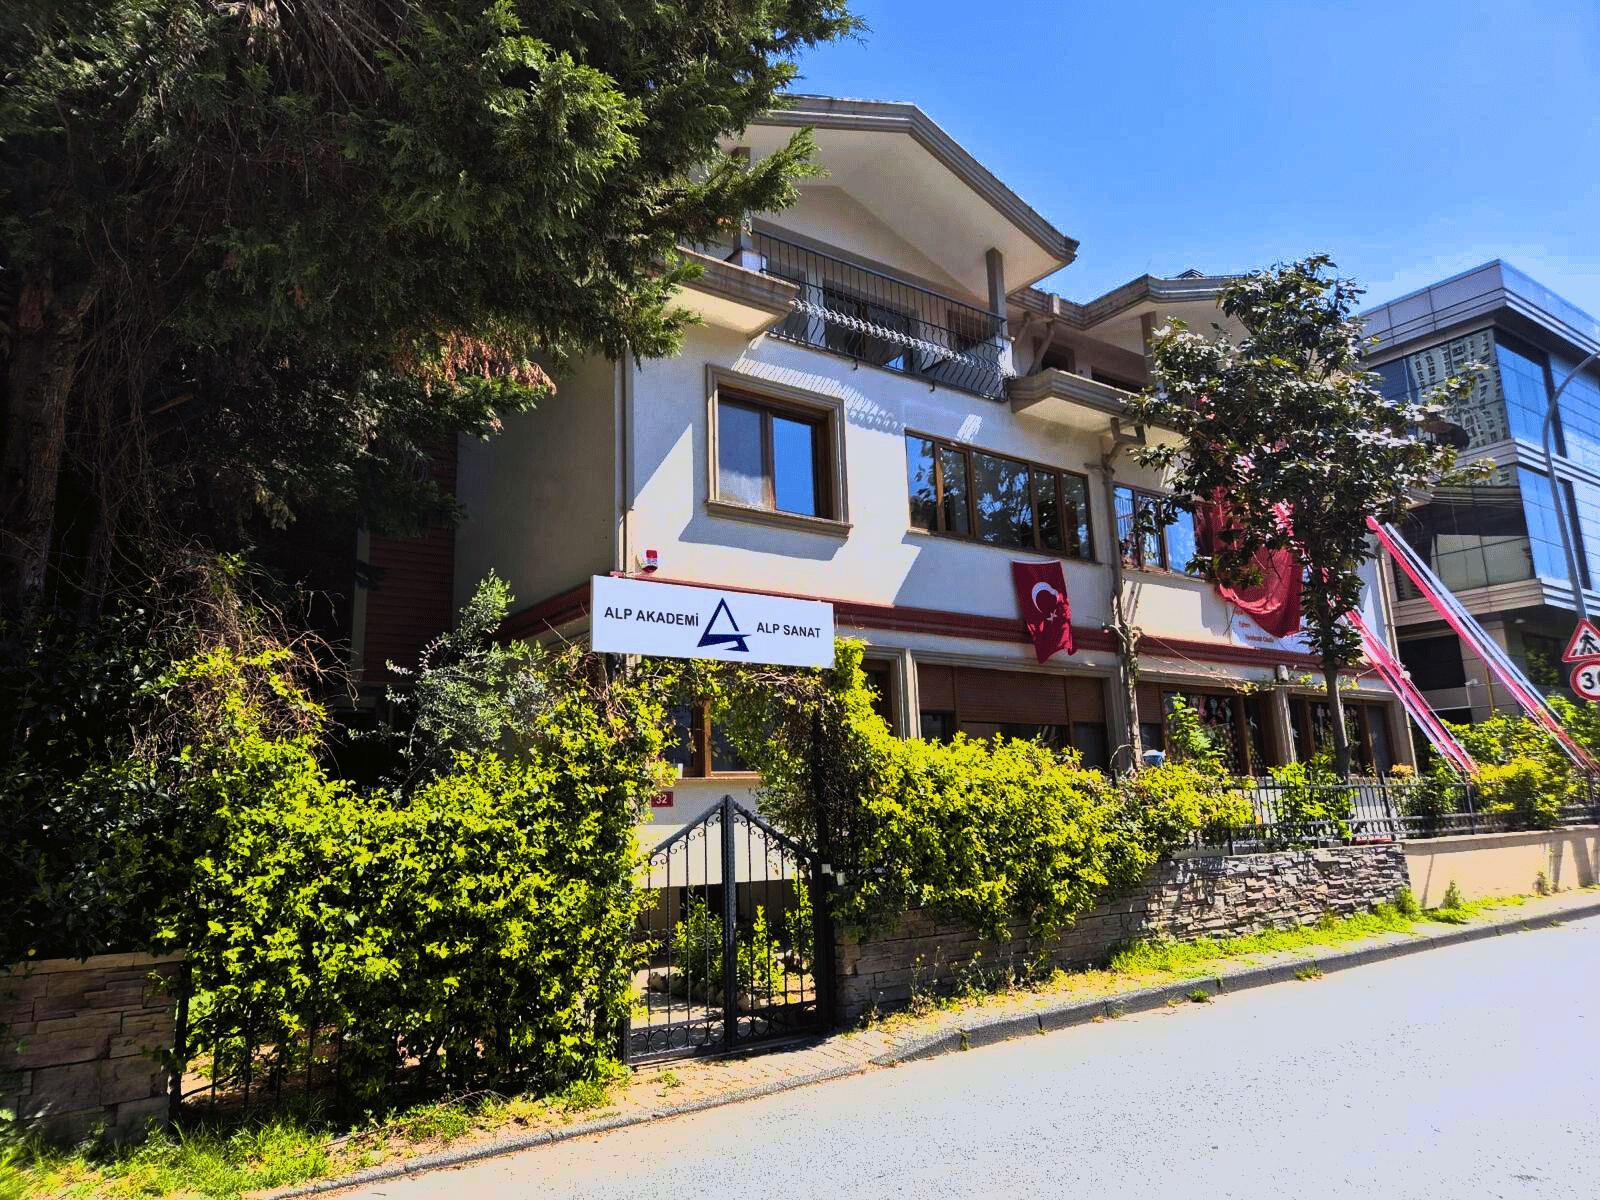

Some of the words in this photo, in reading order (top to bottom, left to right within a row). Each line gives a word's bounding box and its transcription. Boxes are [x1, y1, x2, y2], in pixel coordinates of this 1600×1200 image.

[604, 606, 632, 620] ALP
[636, 609, 699, 627] AKADEMİ
[756, 622, 780, 634] ALP
[783, 625, 821, 638] SANAT
[1581, 672, 1600, 690] 3
